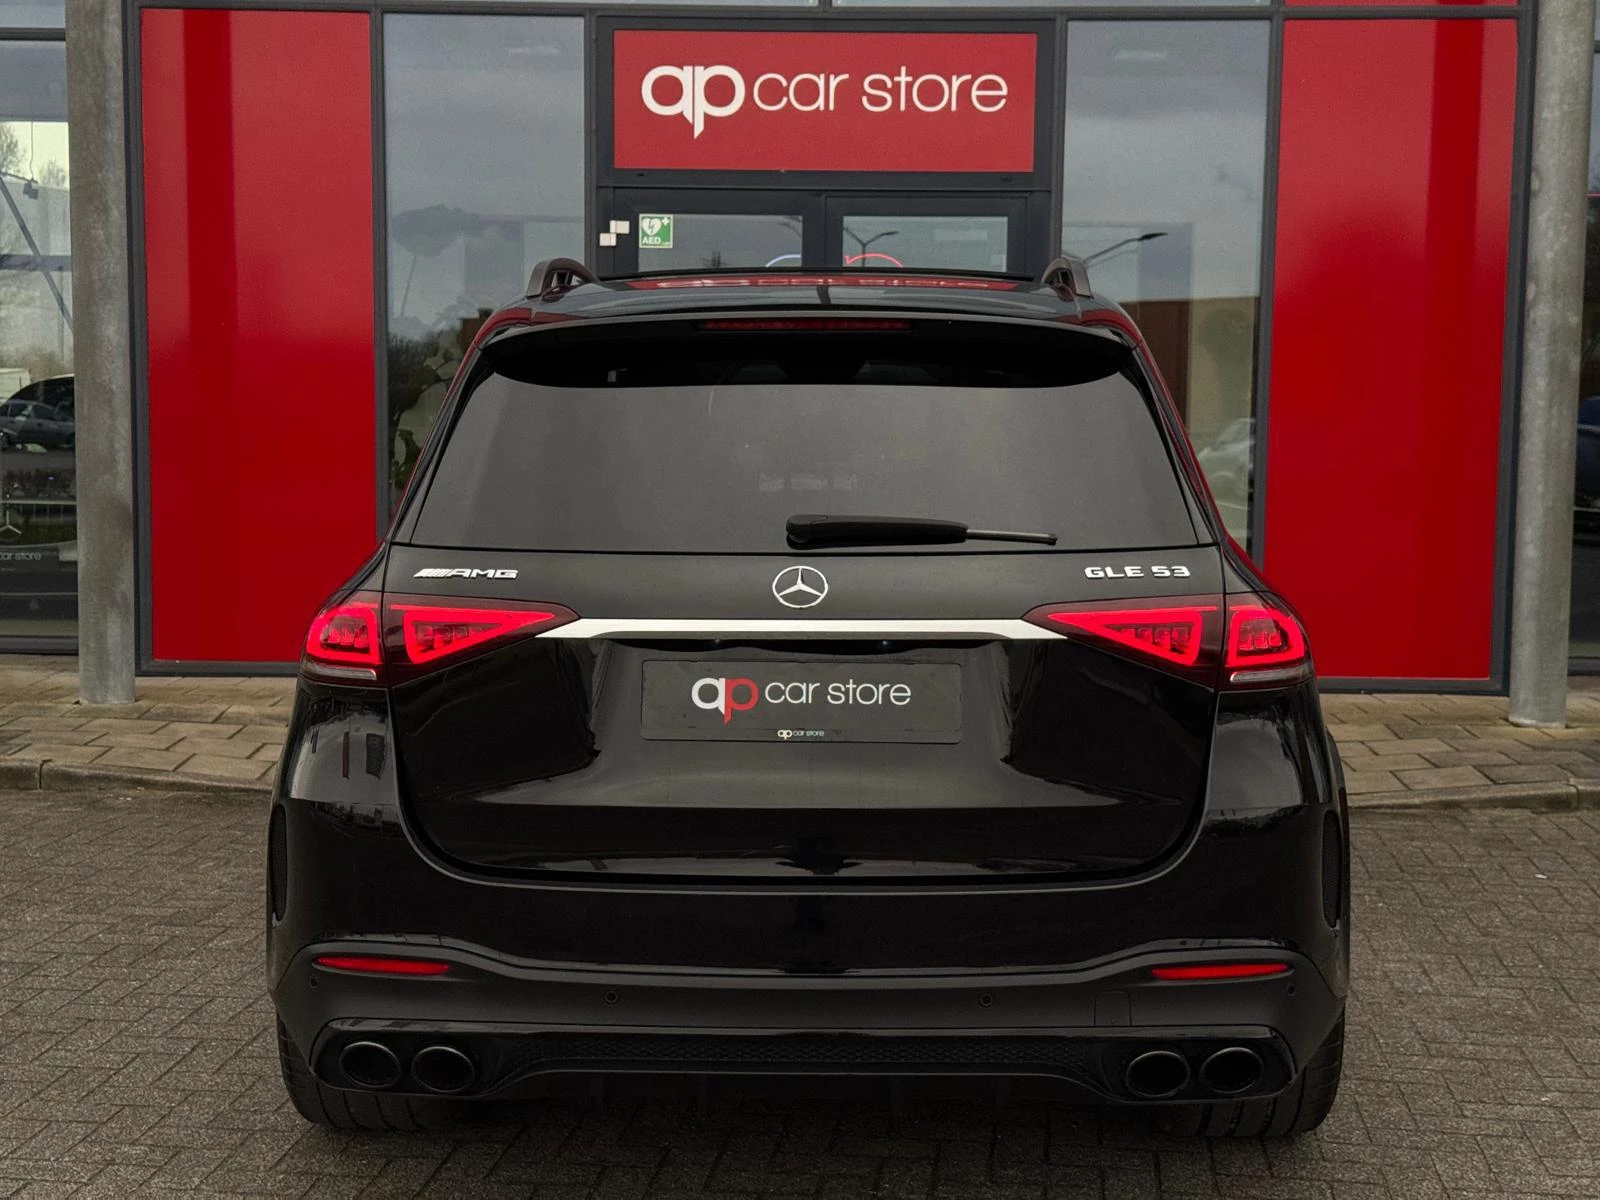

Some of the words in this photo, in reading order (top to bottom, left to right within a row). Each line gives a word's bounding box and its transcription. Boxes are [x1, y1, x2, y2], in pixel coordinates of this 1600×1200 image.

[753, 73, 850, 112] car
[862, 66, 1008, 113] store
[642, 236, 662, 245] AED
[15, 552, 42, 560] store
[445, 568, 519, 579] AMG
[1084, 566, 1145, 578] GLE
[1151, 565, 1191, 577] 53
[764, 681, 821, 704] car
[826, 678, 912, 706] store
